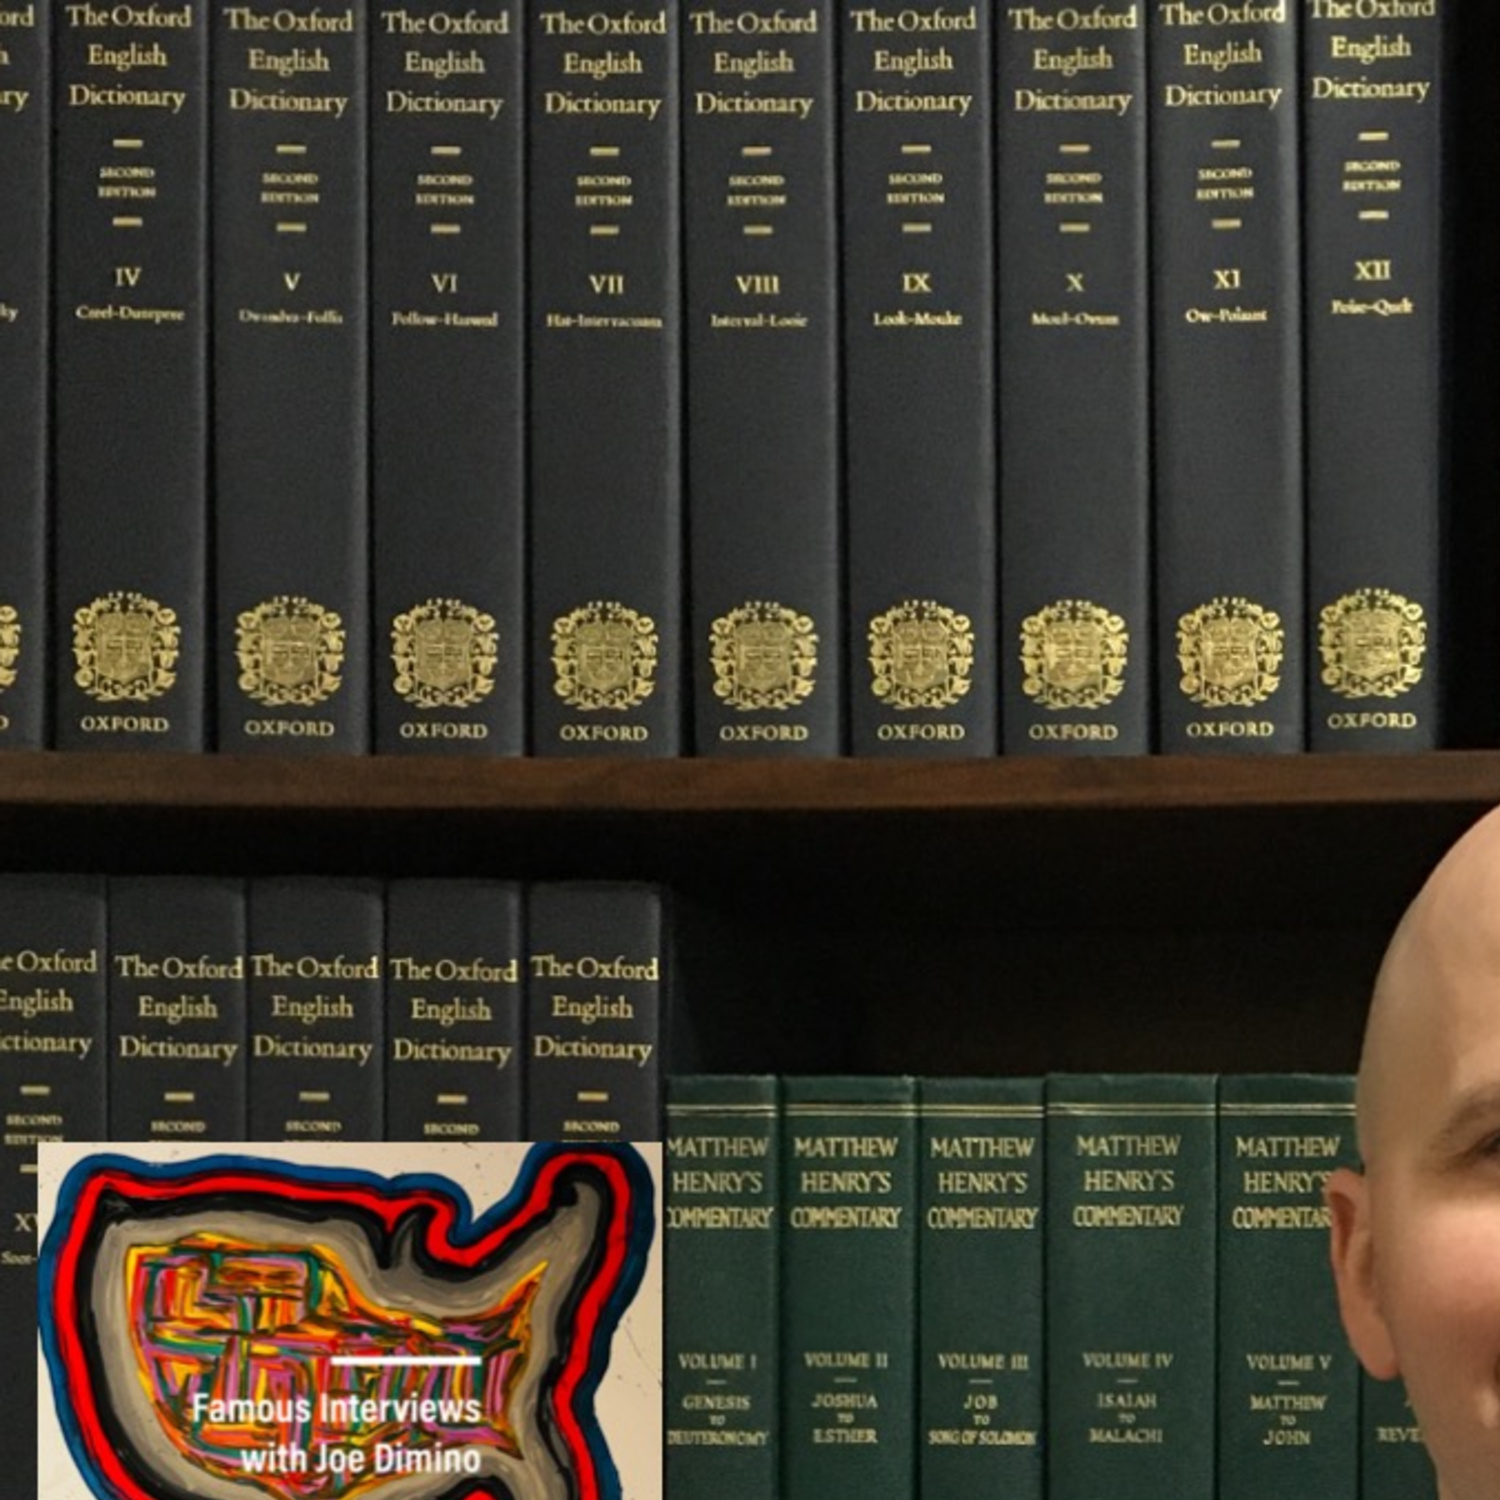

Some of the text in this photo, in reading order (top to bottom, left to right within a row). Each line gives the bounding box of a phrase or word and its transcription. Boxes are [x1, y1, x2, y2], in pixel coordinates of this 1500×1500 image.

[539, 11, 667, 34] The Oxford
[850, 8, 977, 32] The Oxford
[1159, 1, 1287, 26] The Oxford
[564, 50, 643, 80] English
[874, 46, 954, 78] English
[1183, 39, 1263, 72] English
[545, 92, 662, 121] Dictionary
[856, 90, 973, 117] Dictionary
[1165, 84, 1284, 110] Dictionary
[589, 274, 624, 294] VII
[903, 273, 931, 292] IX
[1214, 269, 1240, 289] XI
[80, 716, 170, 733] OXFORD
[251, 953, 380, 980] The Oxford
[271, 994, 354, 1025] English
[254, 1034, 374, 1067] Dictionary
[794, 1136, 899, 1158] MATTHEW
[1077, 1134, 1180, 1157] MATTHEW
[801, 1170, 892, 1194] HENRY'S
[1084, 1169, 1174, 1192] HENRY'S
[791, 1206, 903, 1229] COMMENTARY
[1073, 1205, 1183, 1228] COMMENTARY
[804, 1352, 888, 1369] VOLUME II
[1082, 1352, 1174, 1368] VOLUME IV
[811, 1393, 879, 1409] JOSHUA
[813, 1428, 878, 1444] ESTHER
[1089, 1428, 1163, 1444] MALACHI
